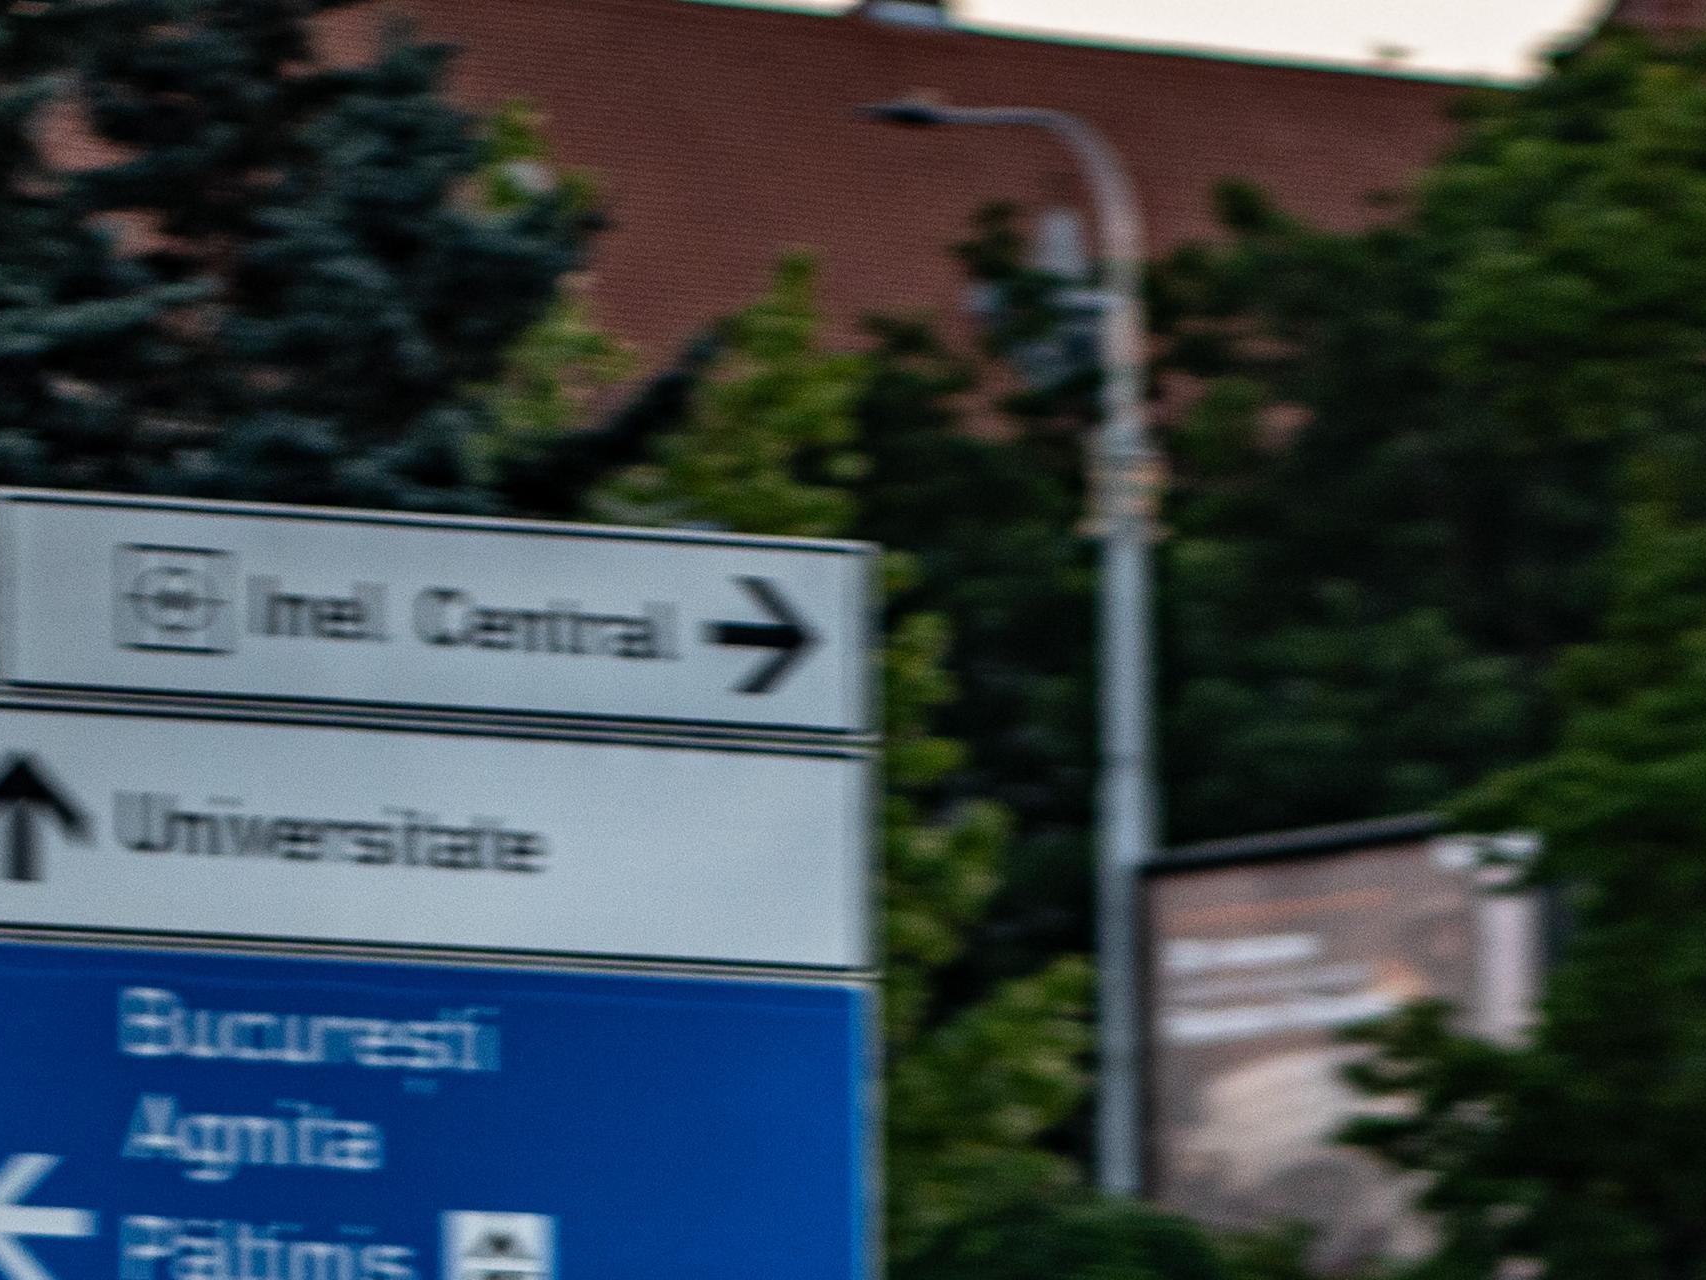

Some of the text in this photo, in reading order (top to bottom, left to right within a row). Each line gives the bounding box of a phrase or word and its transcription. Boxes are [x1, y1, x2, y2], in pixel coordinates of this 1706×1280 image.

[247, 573, 681, 662] Inel Central
[114, 791, 549, 874] Universitate
[125, 1094, 384, 1180] Agnita
